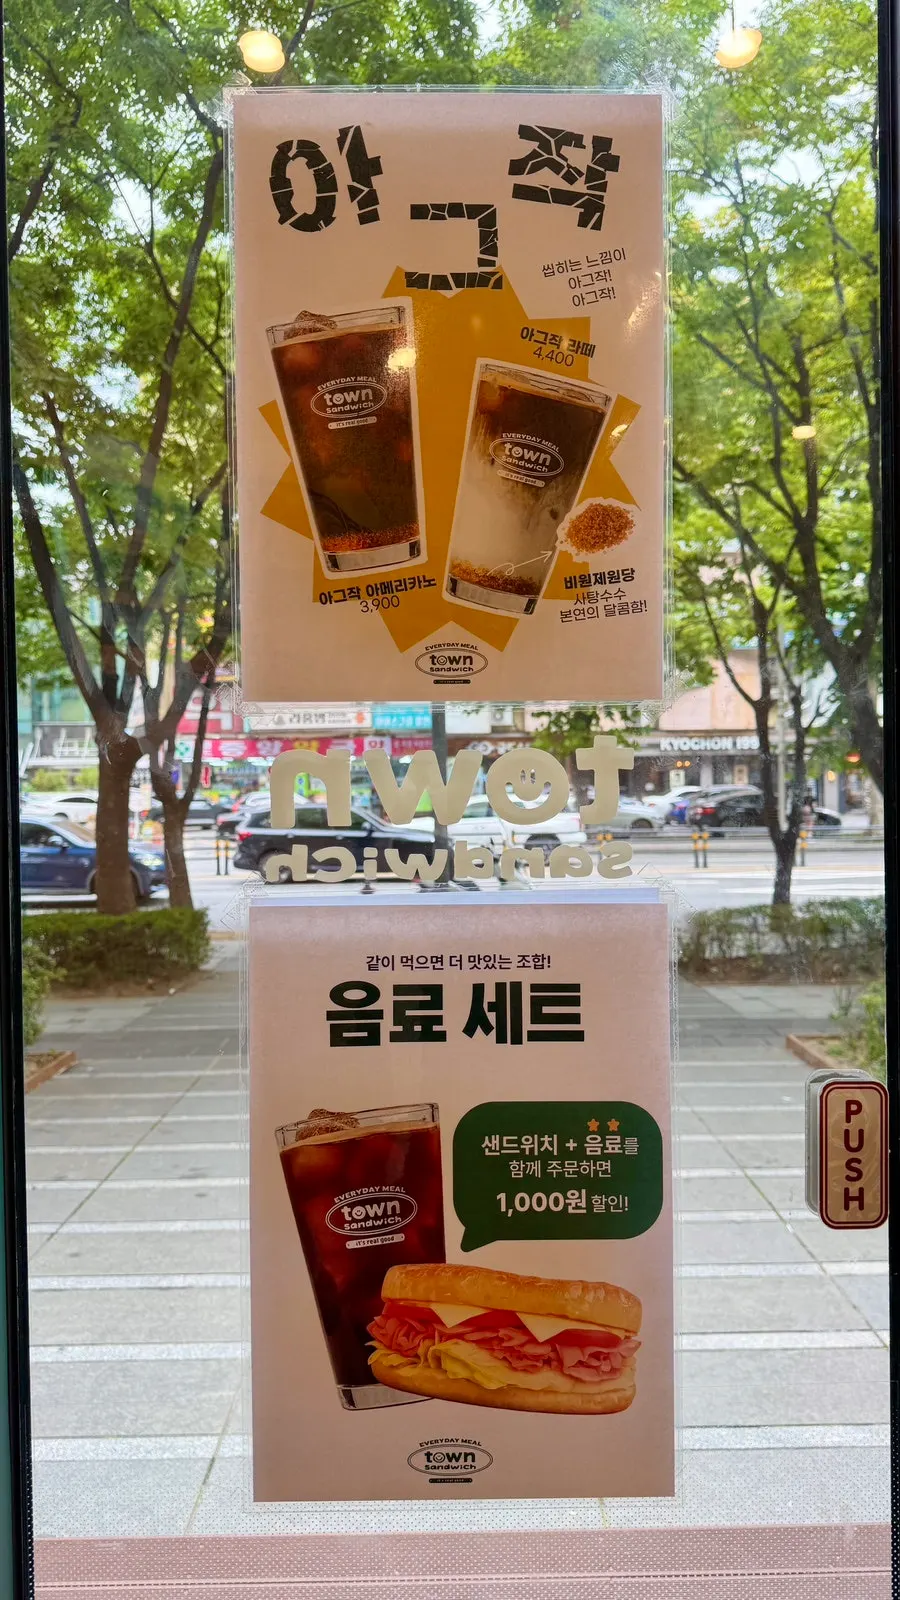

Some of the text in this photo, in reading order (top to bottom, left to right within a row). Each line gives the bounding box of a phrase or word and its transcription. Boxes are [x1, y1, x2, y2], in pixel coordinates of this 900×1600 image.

[542, 247, 627, 278] 씹히는 느낌이
[568, 269, 613, 290] 아그작!
[572, 286, 617, 307] 아그작!
[520, 326, 597, 358] 아그작 라떼
[533, 346, 574, 367] 4,400
[317, 376, 356, 391] EVERYDAY
[323, 388, 373, 406] town
[326, 401, 375, 414] sandwich
[502, 432, 560, 453] EVERYDAY MEAL
[504, 442, 552, 466] town
[501, 455, 548, 473] sandwich
[319, 575, 437, 606] 아그작 아메리카노
[574, 587, 627, 606] 사탕수수
[360, 595, 400, 613] 3,900
[560, 599, 648, 623] 본연의 달콤함!
[425, 642, 460, 651] EVERYDAY
[429, 654, 474, 666] town
[660, 737, 733, 750] KYOCHON
[366, 953, 551, 971] 같이 먹으면 더 맛있는 조합!
[326, 980, 585, 1047] 음료 세트
[481, 1134, 558, 1156] 샌드위치
[584, 1134, 640, 1156] 음료를
[843, 1099, 864, 1211] PUSH
[509, 1159, 612, 1178] 함께 주문하면
[334, 1185, 406, 1203] EVERYDAY MEAL
[496, 1189, 629, 1217] 1,000원 할인!
[341, 1200, 401, 1221] town
[344, 1216, 402, 1230] sandwich
[419, 1438, 482, 1447] EVERYDAY MEAL
[424, 1451, 476, 1463] town
